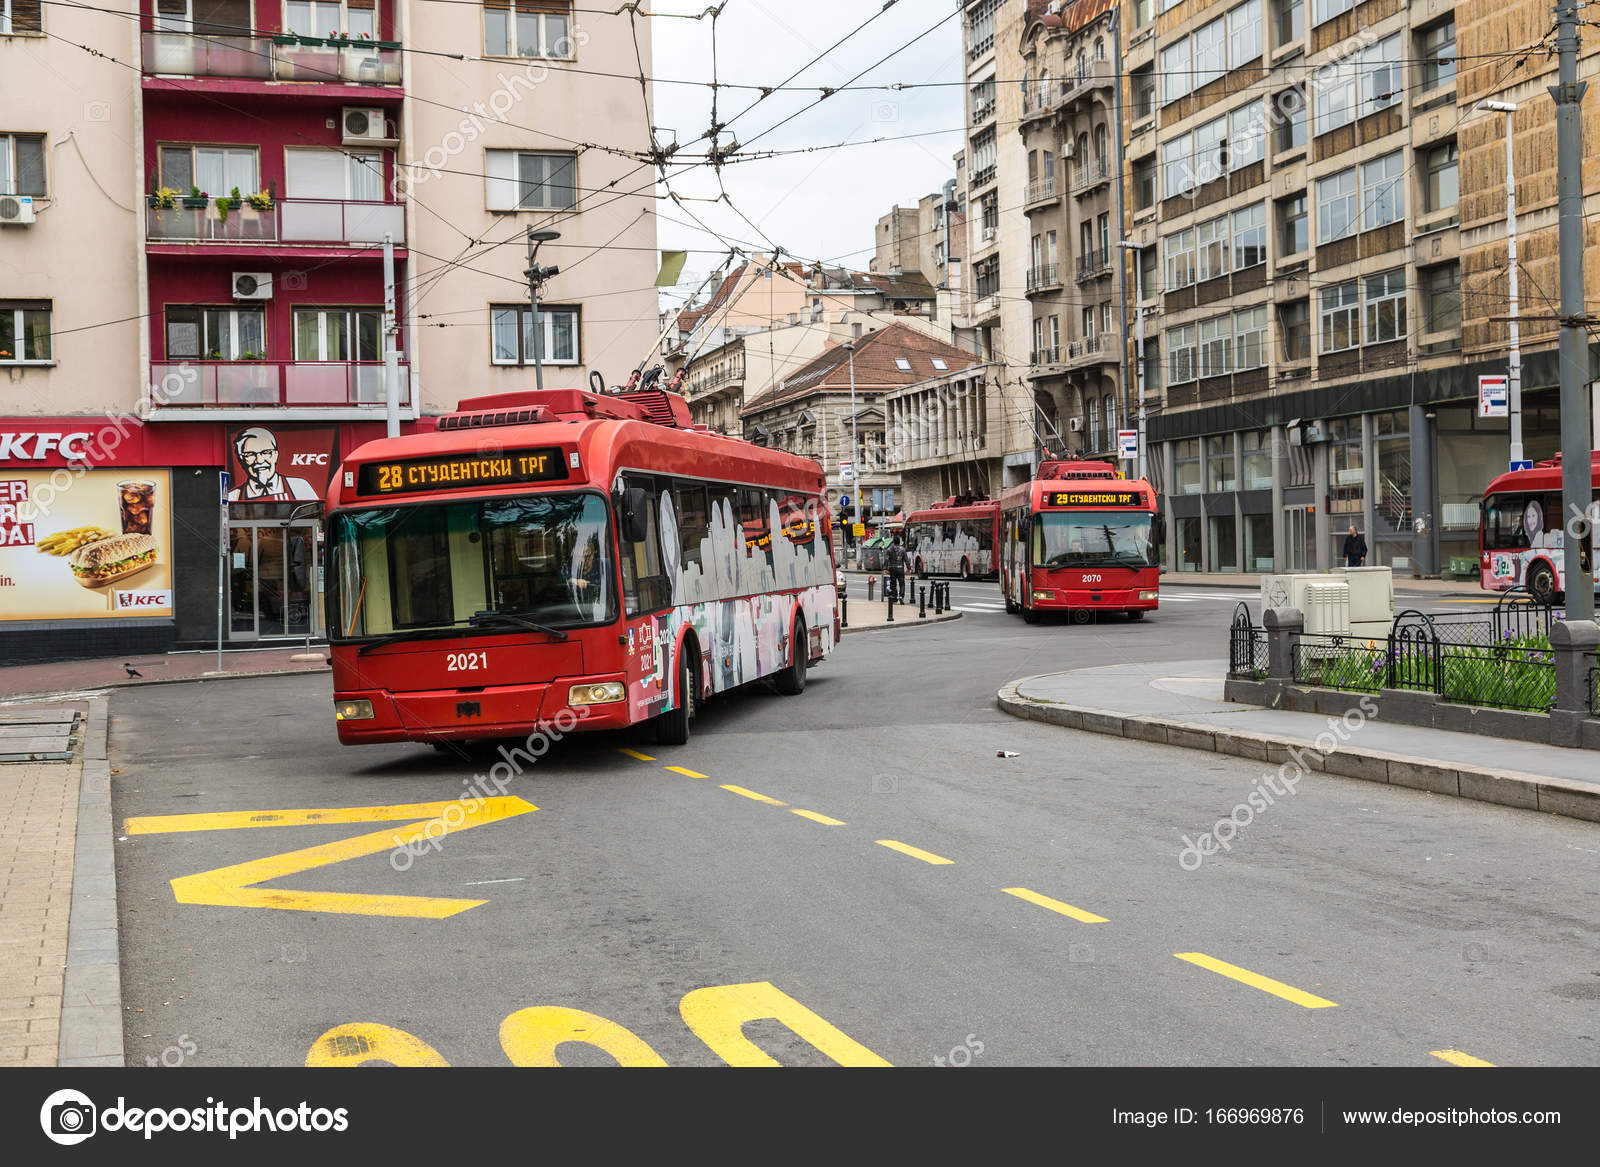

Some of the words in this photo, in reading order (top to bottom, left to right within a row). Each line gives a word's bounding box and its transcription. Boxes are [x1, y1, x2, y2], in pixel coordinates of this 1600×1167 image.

[0, 432, 89, 460] KFC
[290, 453, 329, 466] KFC
[378, 465, 403, 489] 28
[408, 458, 512, 484] СТУДЕНТСКИ
[519, 455, 548, 475] ТРГ
[1056, 493, 1069, 504] 29
[1070, 494, 1116, 503] СТУДЕНТСКИ
[1119, 494, 1132, 503] ТРГ
[1082, 574, 1102, 583] 2070
[134, 595, 166, 606] KFC
[446, 652, 488, 671] 2021
[641, 653, 652, 672] 2021
